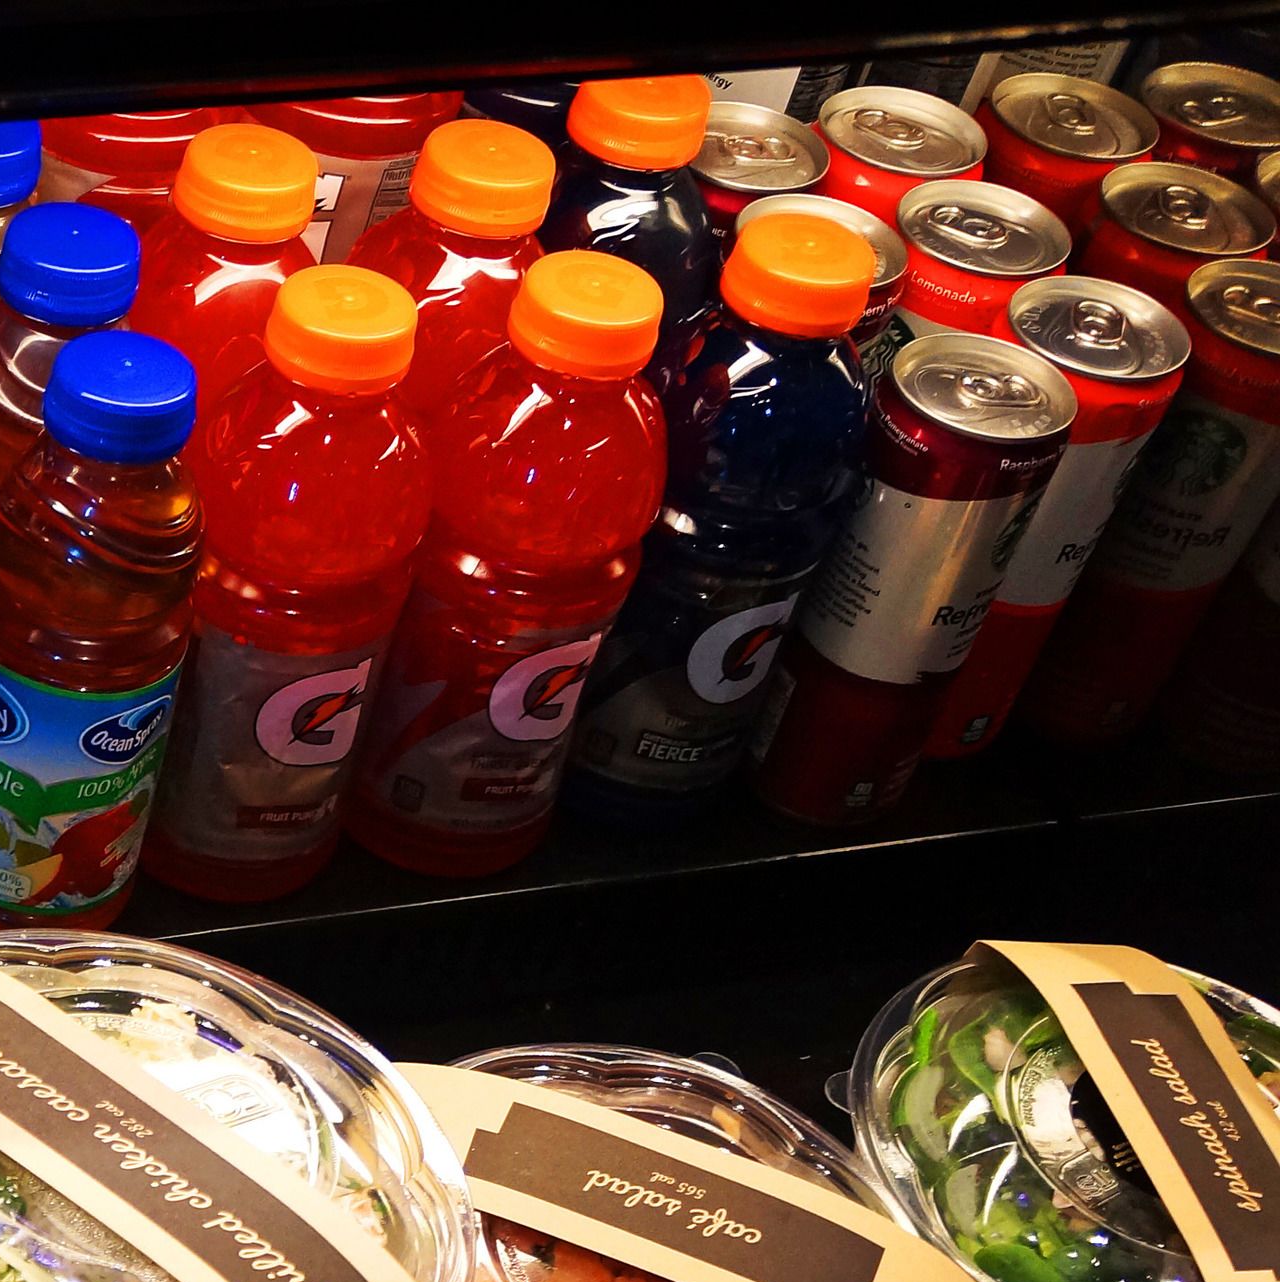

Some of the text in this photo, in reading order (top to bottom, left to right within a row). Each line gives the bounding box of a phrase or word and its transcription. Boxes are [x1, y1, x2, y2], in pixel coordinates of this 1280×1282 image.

[911, 270, 977, 305] Lemonade
[91, 710, 163, 752] Ocean Spray
[255, 657, 373, 767] G
[637, 742, 704, 763] FIERCE
[77, 777, 125, 798] 100%
[96, 1100, 156, 1139] 282 cal
[1130, 1037, 1264, 1213] spinach salad
[1206, 1100, 1228, 1124] cal
[95, 1121, 214, 1204] chicken
[650, 1170, 708, 1200] 565 cal
[582, 1169, 763, 1246] café salad
